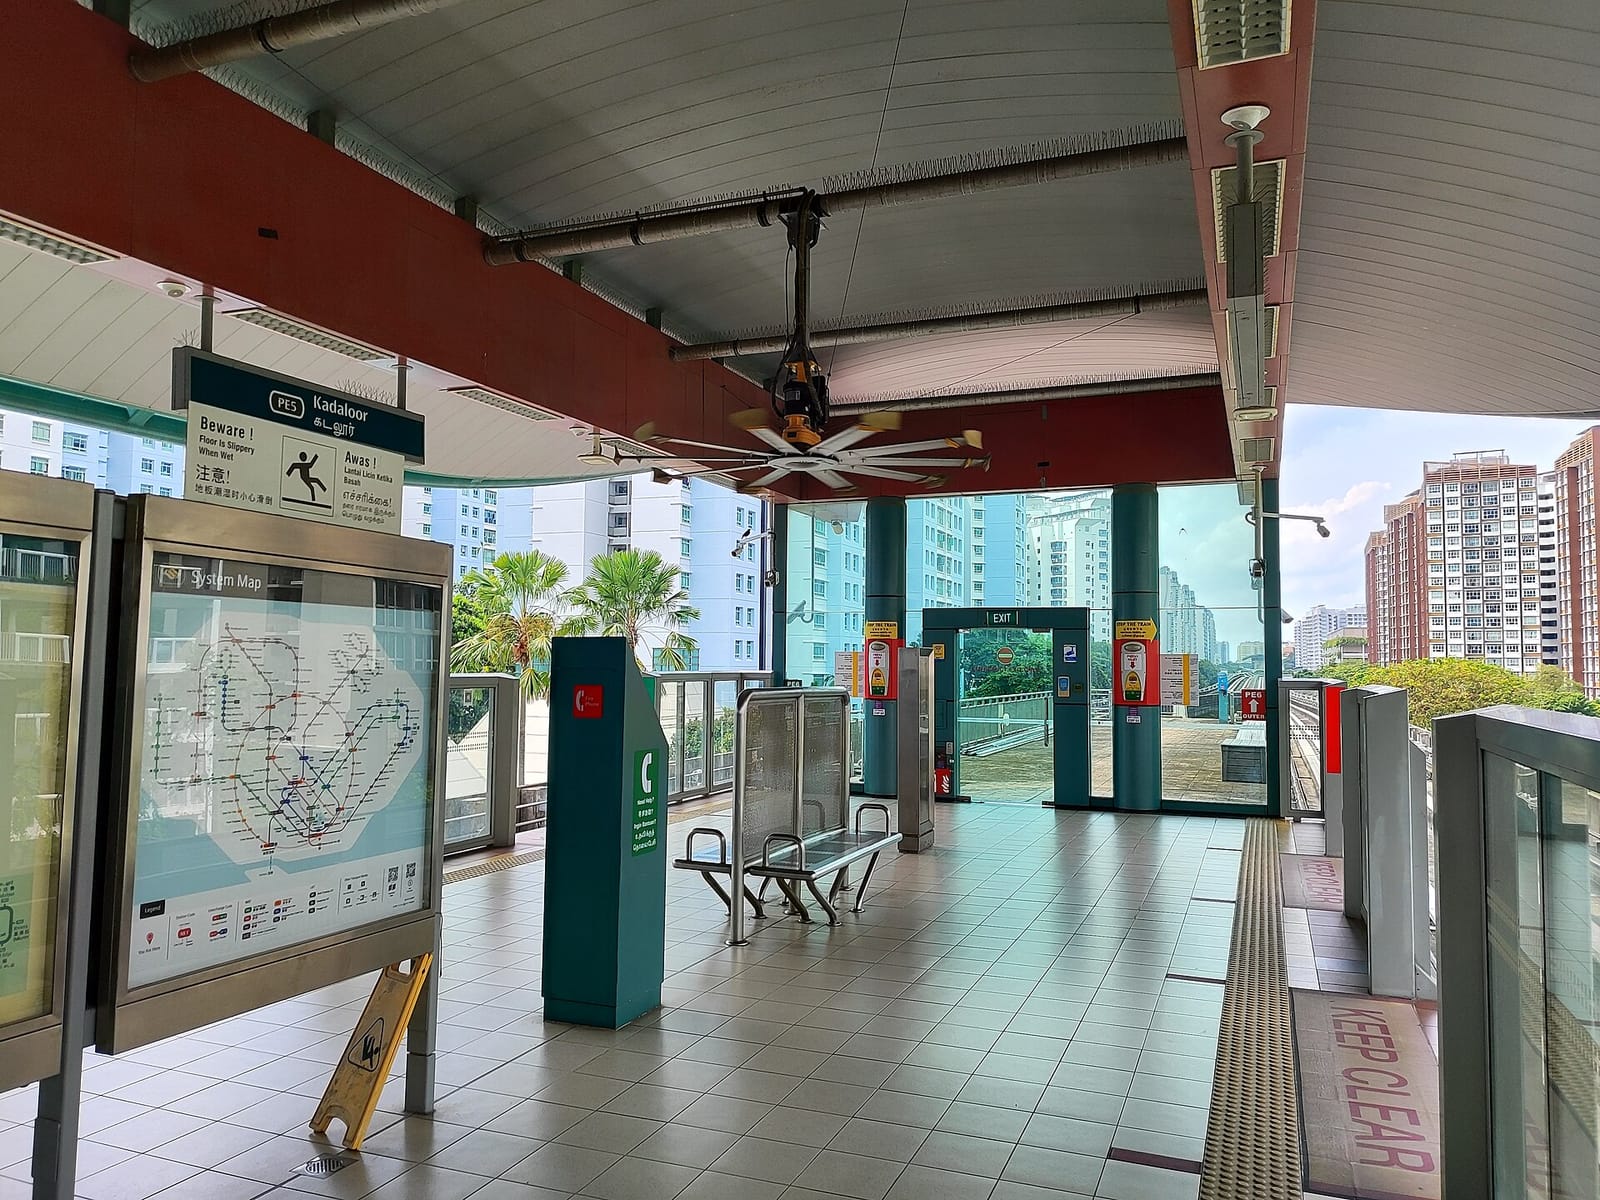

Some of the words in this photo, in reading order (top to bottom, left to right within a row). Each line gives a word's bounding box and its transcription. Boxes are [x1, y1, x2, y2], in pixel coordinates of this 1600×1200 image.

[277, 398, 297, 412] PE5
[313, 395, 369, 423] Kadaloor
[200, 416, 245, 440] Beware
[313, 417, 356, 438] கடலூர்
[198, 446, 219, 459] When
[220, 451, 234, 462] Wet
[199, 434, 218, 448] Floor
[219, 439, 226, 450] Is
[227, 440, 255, 456] Slippery
[344, 450, 370, 468] Awas
[191, 569, 234, 588] System
[237, 574, 261, 591] Map
[993, 613, 1012, 624] EXIT
[144, 904, 161, 914] Legend
[1330, 1004, 1399, 1063] KEEP
[1340, 1066, 1436, 1173] CLEAR
